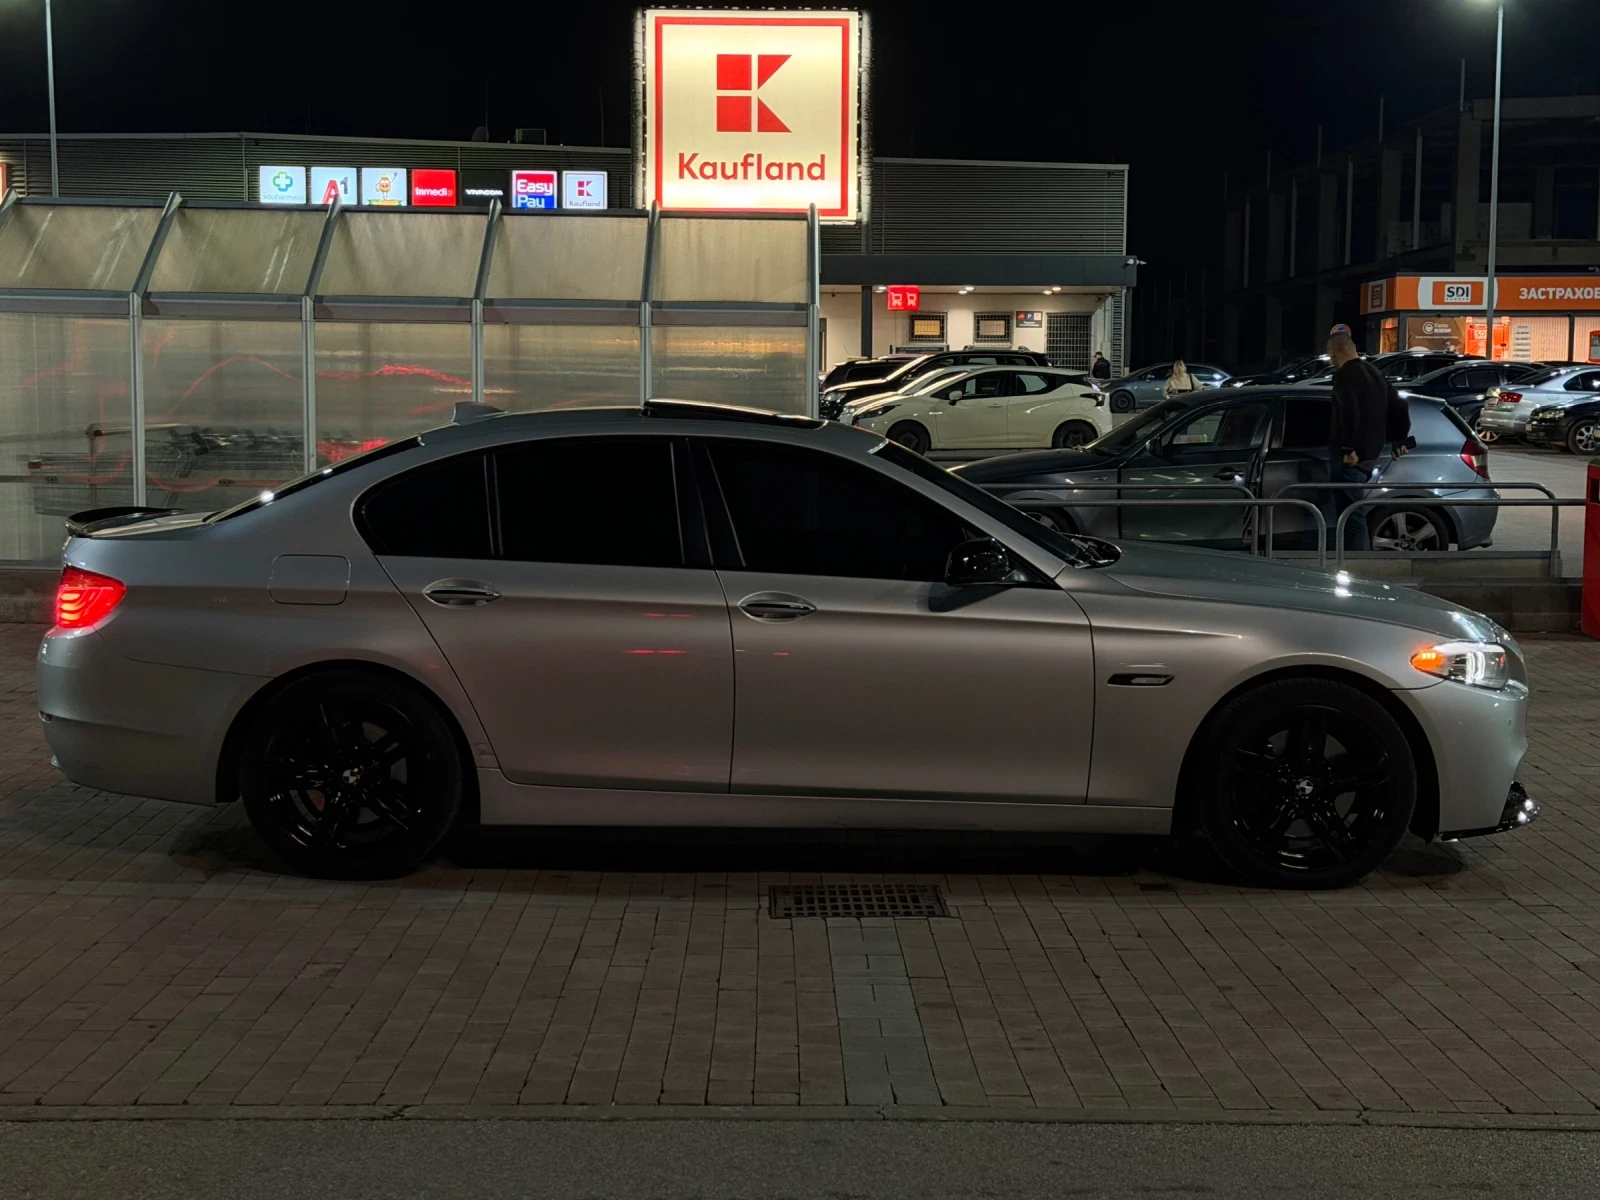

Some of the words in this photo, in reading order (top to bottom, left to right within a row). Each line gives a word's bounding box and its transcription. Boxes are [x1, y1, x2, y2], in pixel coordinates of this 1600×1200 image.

[678, 152, 826, 181] Kaufland
[321, 176, 349, 205] A1
[516, 179, 553, 196] Easy
[517, 194, 545, 208] Pay
[1446, 286, 1470, 298] SDI
